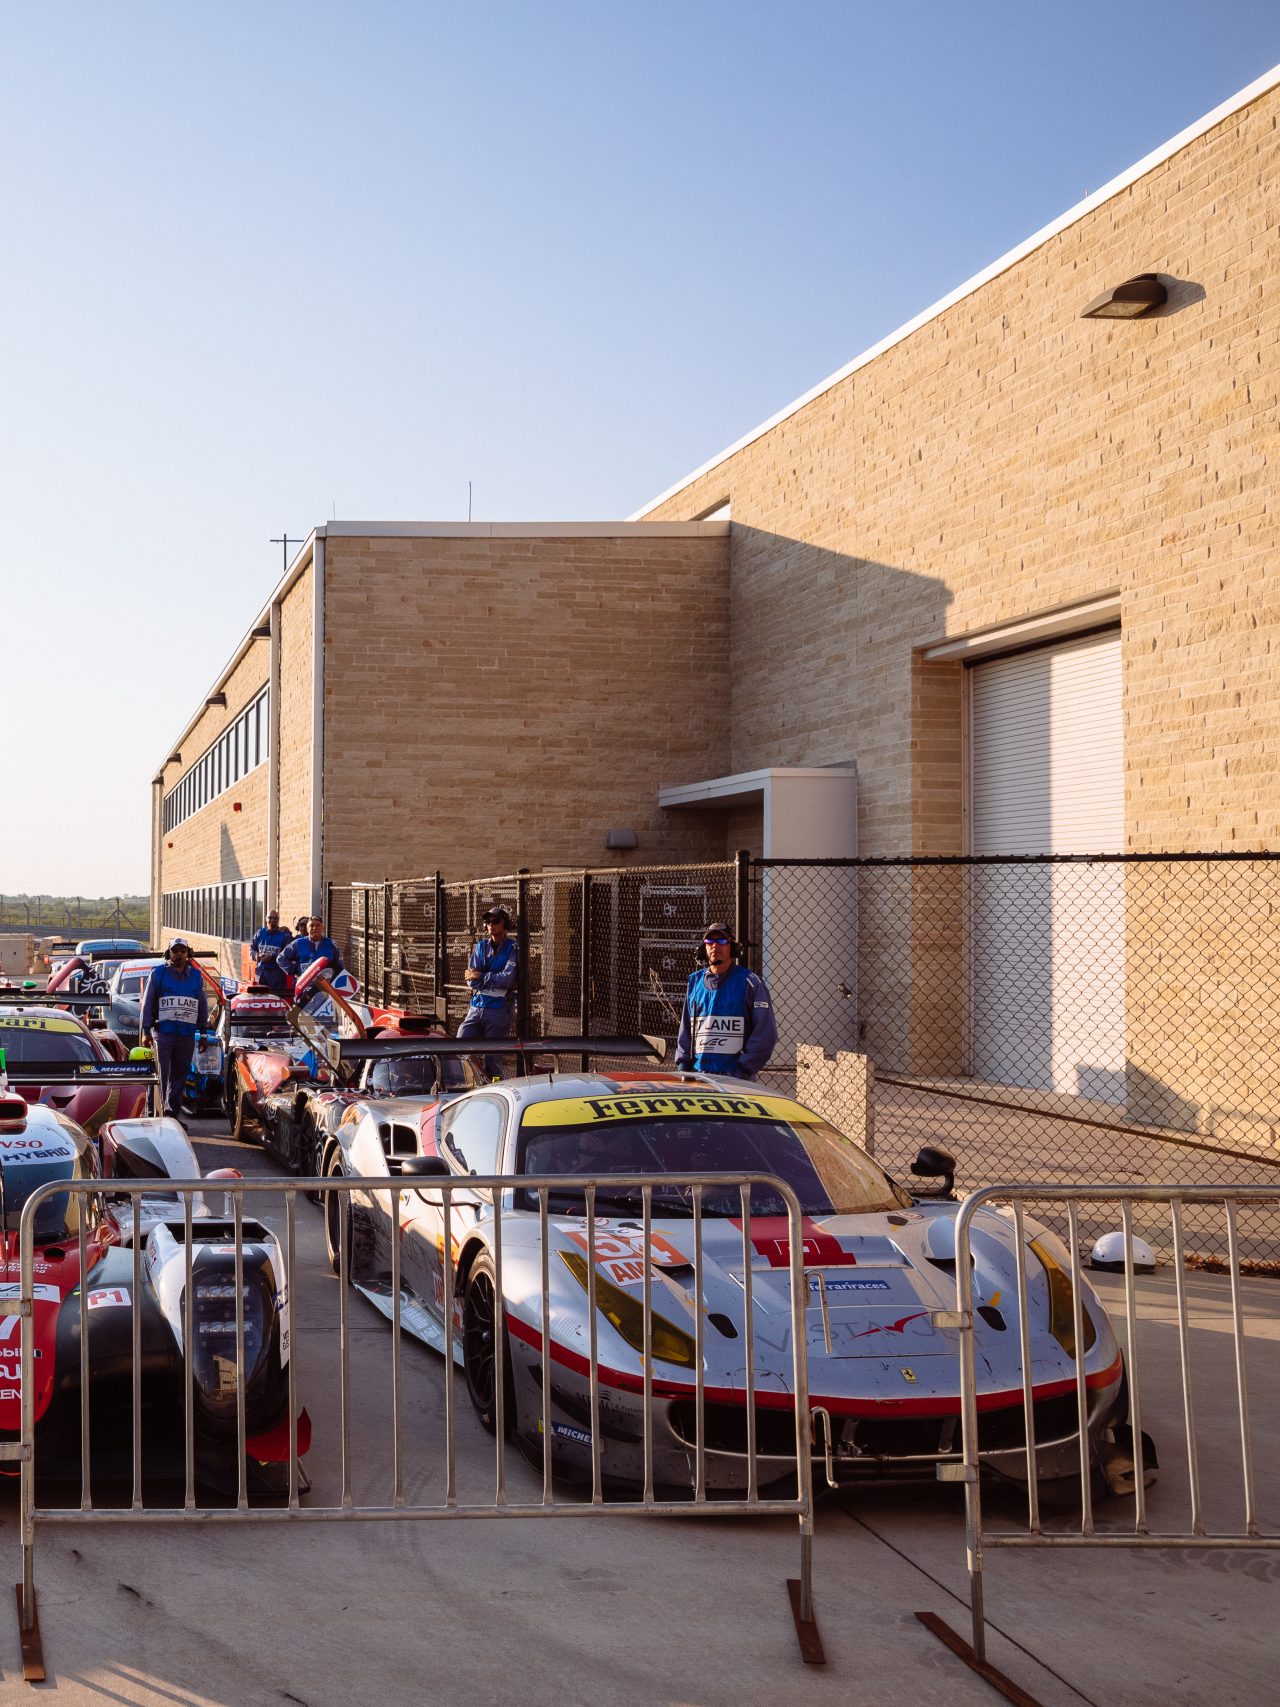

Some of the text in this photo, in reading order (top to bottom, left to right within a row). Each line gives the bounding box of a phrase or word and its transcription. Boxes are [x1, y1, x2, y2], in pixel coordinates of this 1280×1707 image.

[161, 998, 197, 1009] PIT LANE
[704, 1019, 741, 1031] LANE
[584, 1098, 774, 1120] Ferrari
[2, 1147, 71, 1162] HYBRID
[609, 1261, 656, 1283] AM
[89, 1289, 124, 1306] P1
[557, 1425, 593, 1444] MICHE
